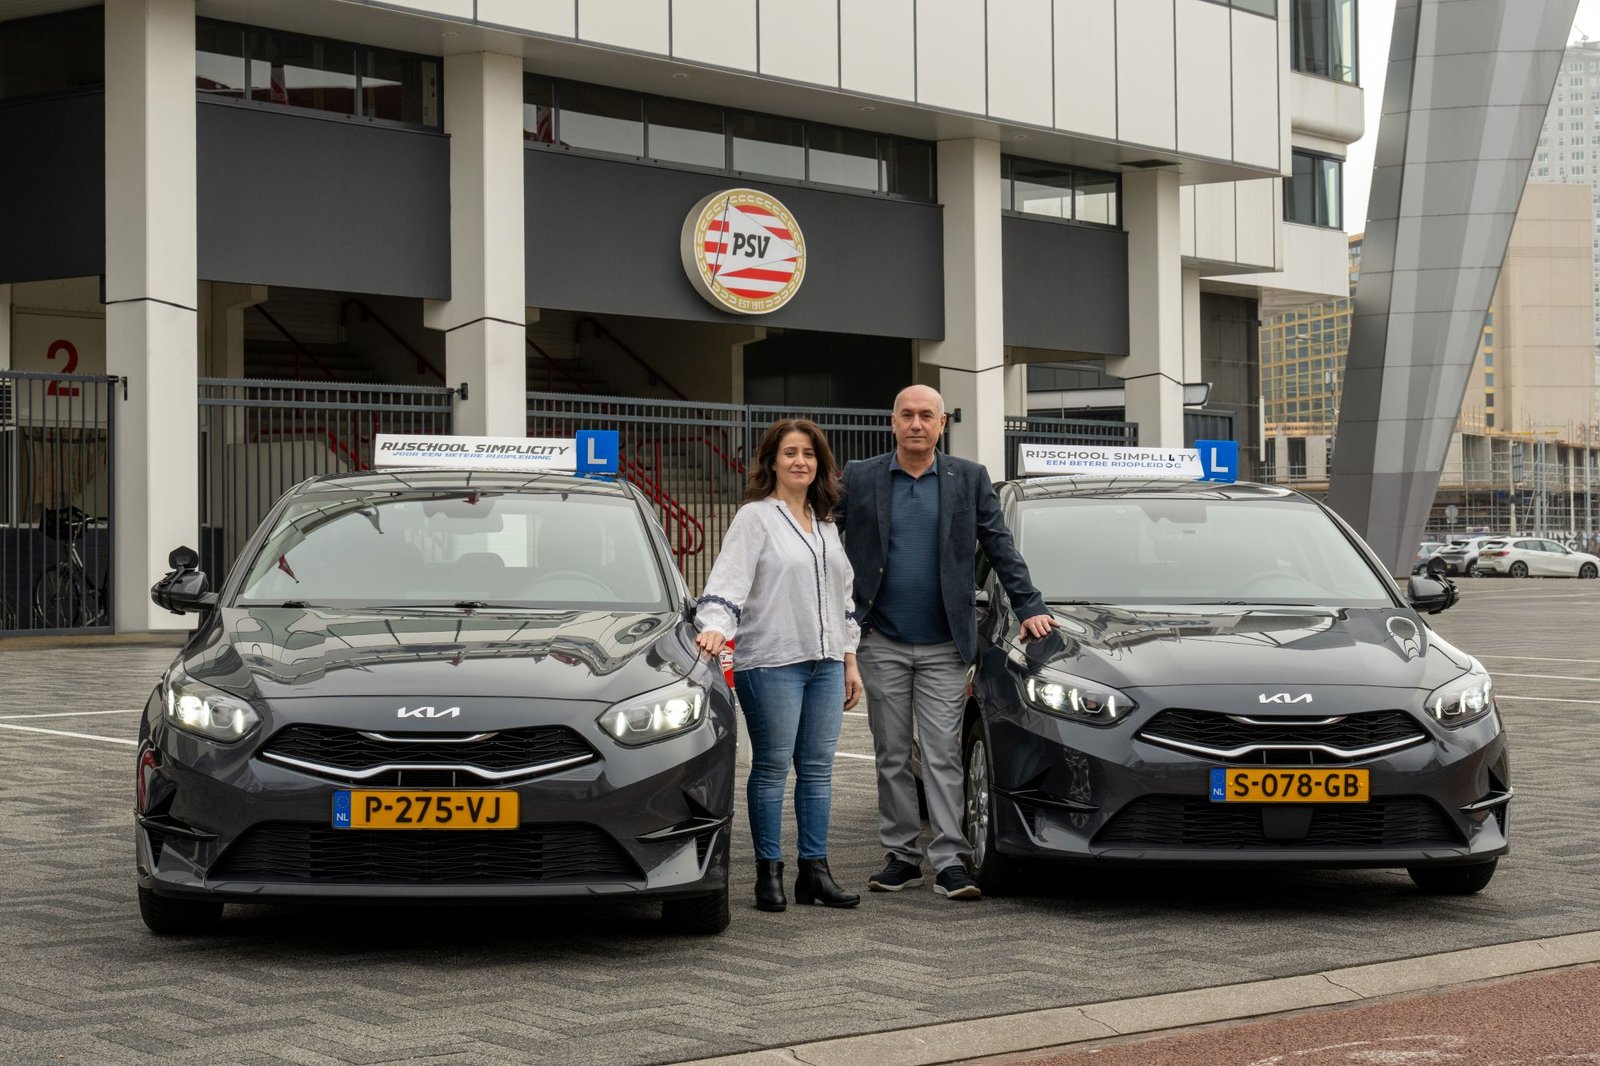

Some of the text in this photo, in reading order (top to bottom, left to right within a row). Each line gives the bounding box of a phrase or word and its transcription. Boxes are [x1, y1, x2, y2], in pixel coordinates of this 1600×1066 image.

[732, 232, 771, 259] PSV
[46, 339, 80, 397] 2
[380, 442, 570, 455] RIJSCHOOL SIMPLICITY
[587, 437, 608, 465] L
[1025, 450, 1110, 460] RIJSCHOOL
[1210, 447, 1229, 473] L
[1258, 692, 1313, 704] KIA
[397, 706, 461, 718] KIA
[1213, 788, 1225, 796] NL
[1233, 773, 1359, 797] S-078-GB
[336, 813, 349, 822] NL
[365, 796, 501, 823] P-275-VJ
